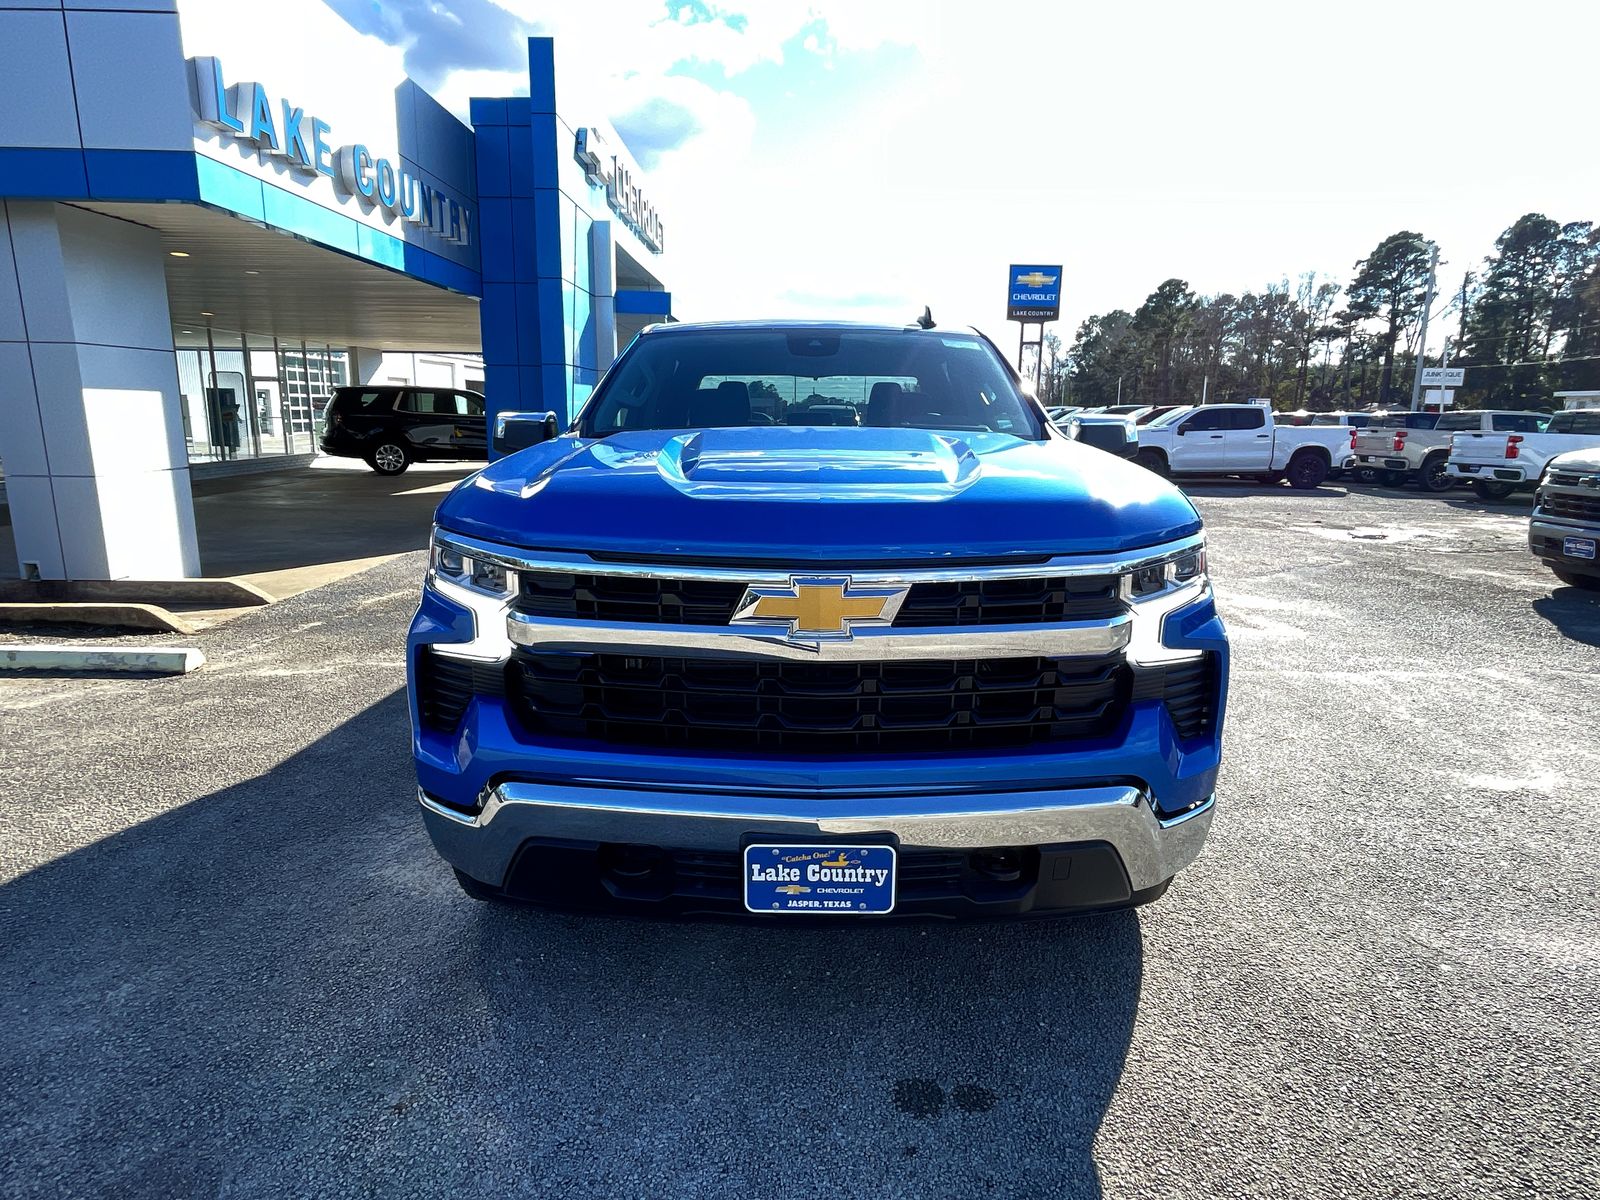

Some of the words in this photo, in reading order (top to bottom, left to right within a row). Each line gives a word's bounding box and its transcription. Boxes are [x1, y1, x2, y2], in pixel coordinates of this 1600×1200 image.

[206, 56, 335, 178] LAKE
[353, 144, 472, 246] COUNTRY
[752, 864, 800, 881] Lake
[807, 864, 888, 887] Country
[787, 900, 822, 908] JASPER,
